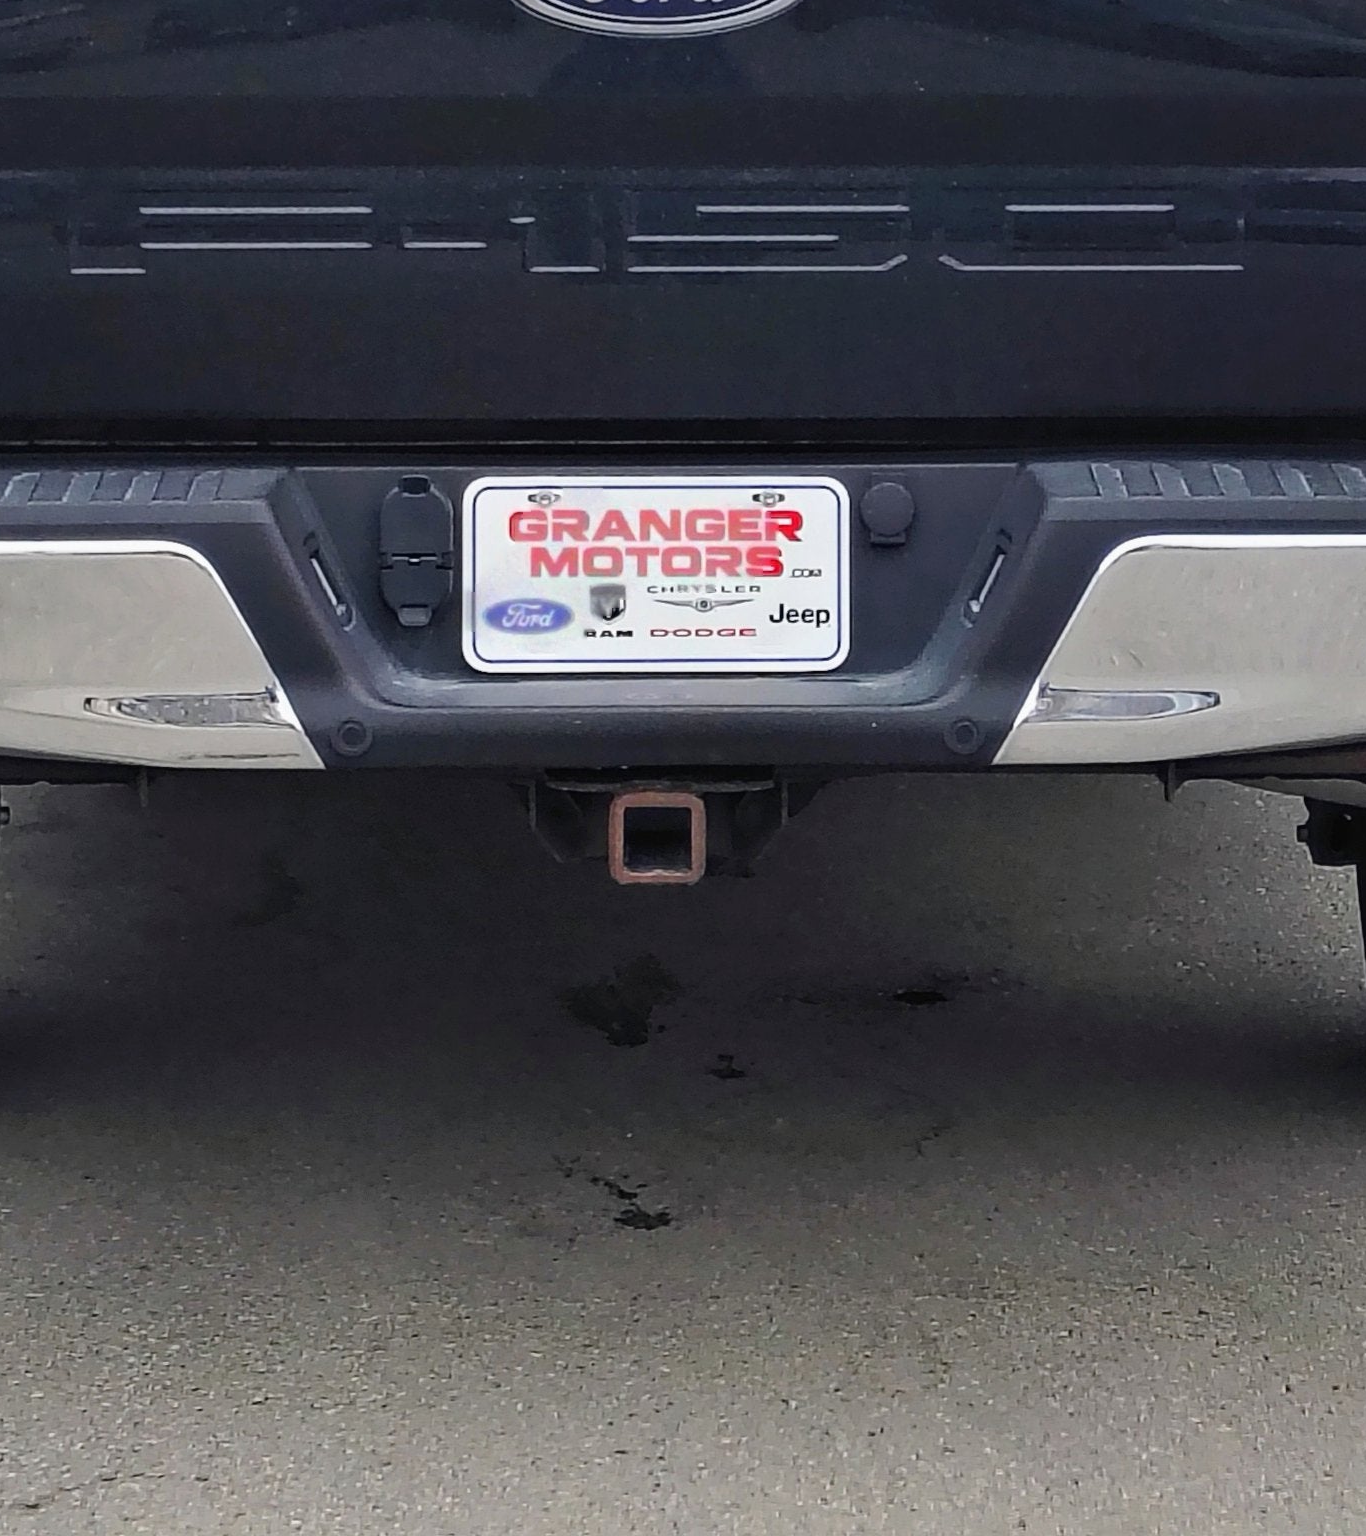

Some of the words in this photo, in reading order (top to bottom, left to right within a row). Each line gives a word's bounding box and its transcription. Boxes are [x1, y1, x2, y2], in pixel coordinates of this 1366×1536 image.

[508, 509, 804, 543] GRANGER
[529, 545, 785, 578] MOTORS
[646, 584, 761, 594] CHRYSLER
[501, 604, 556, 629] Ford
[769, 602, 831, 628] Jeep
[584, 629, 634, 639] RAM
[649, 627, 758, 638] DODGE
